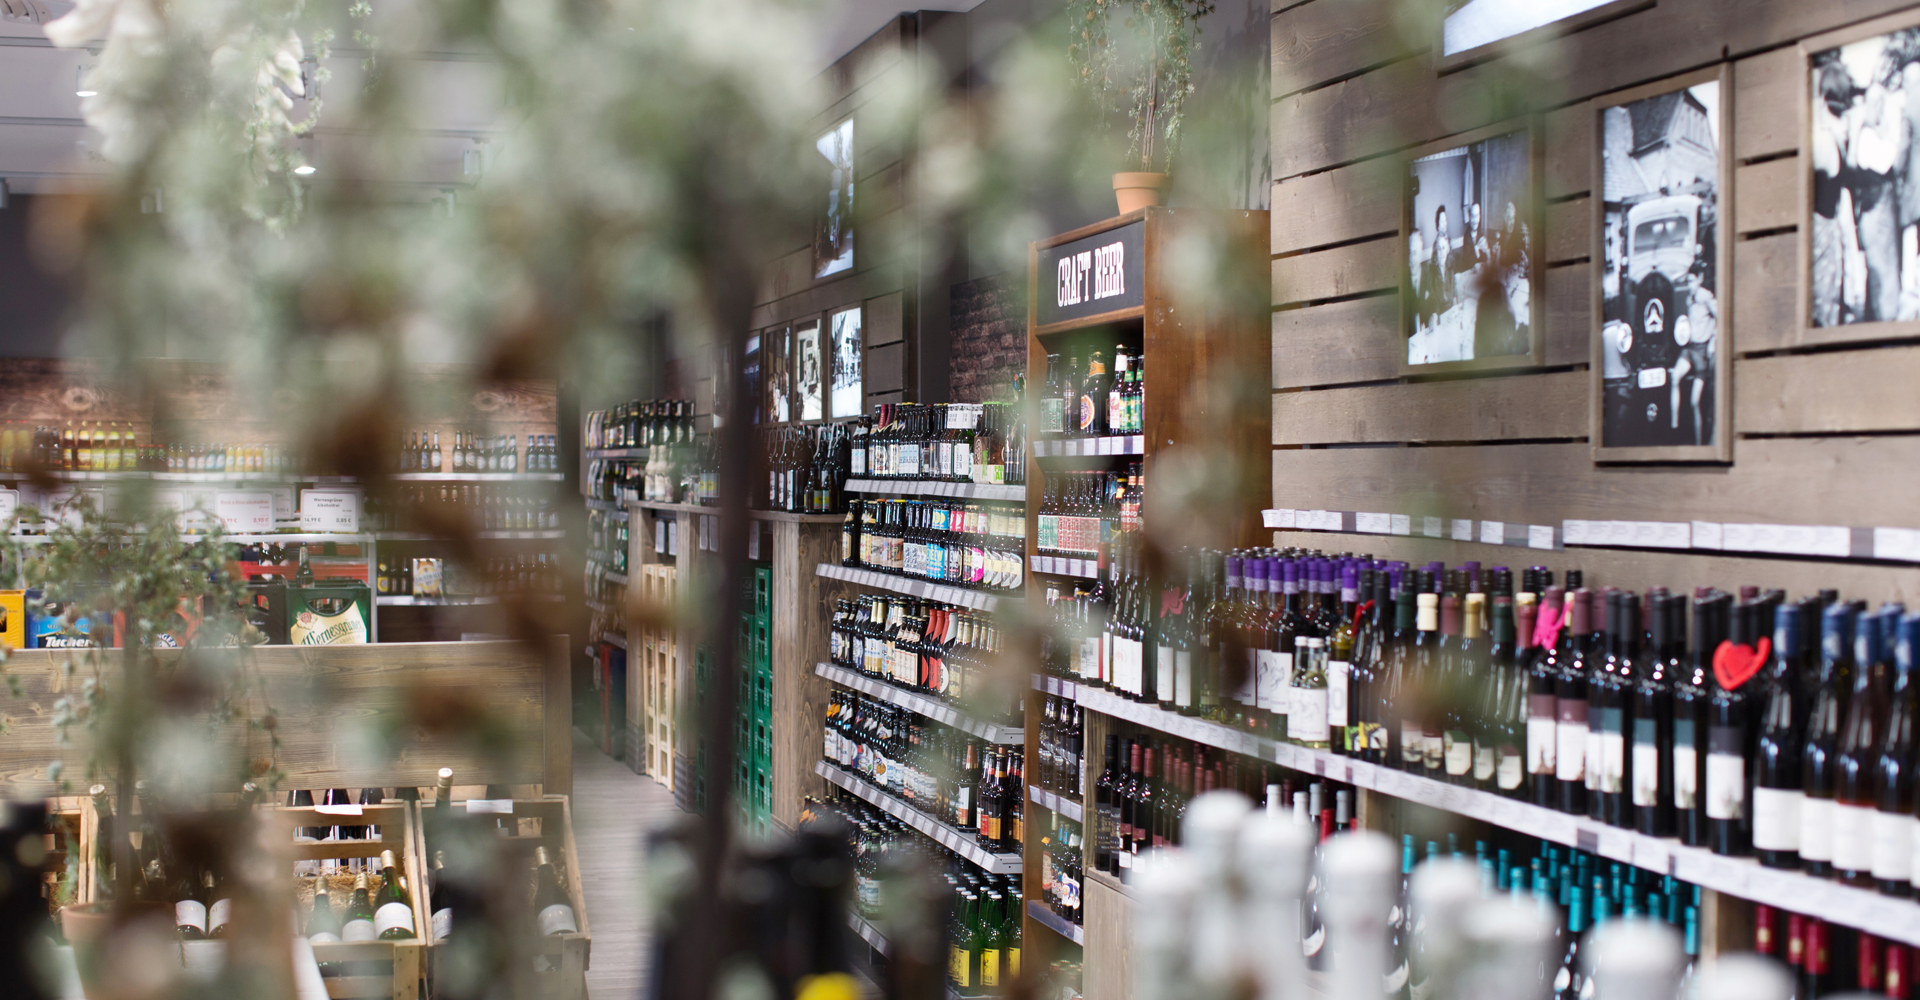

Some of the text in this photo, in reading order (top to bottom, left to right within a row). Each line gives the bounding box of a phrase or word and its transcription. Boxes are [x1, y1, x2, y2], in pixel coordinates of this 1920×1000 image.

[1057, 241, 1125, 307] CRAFT BEER
[45, 636, 94, 648] Tucher
